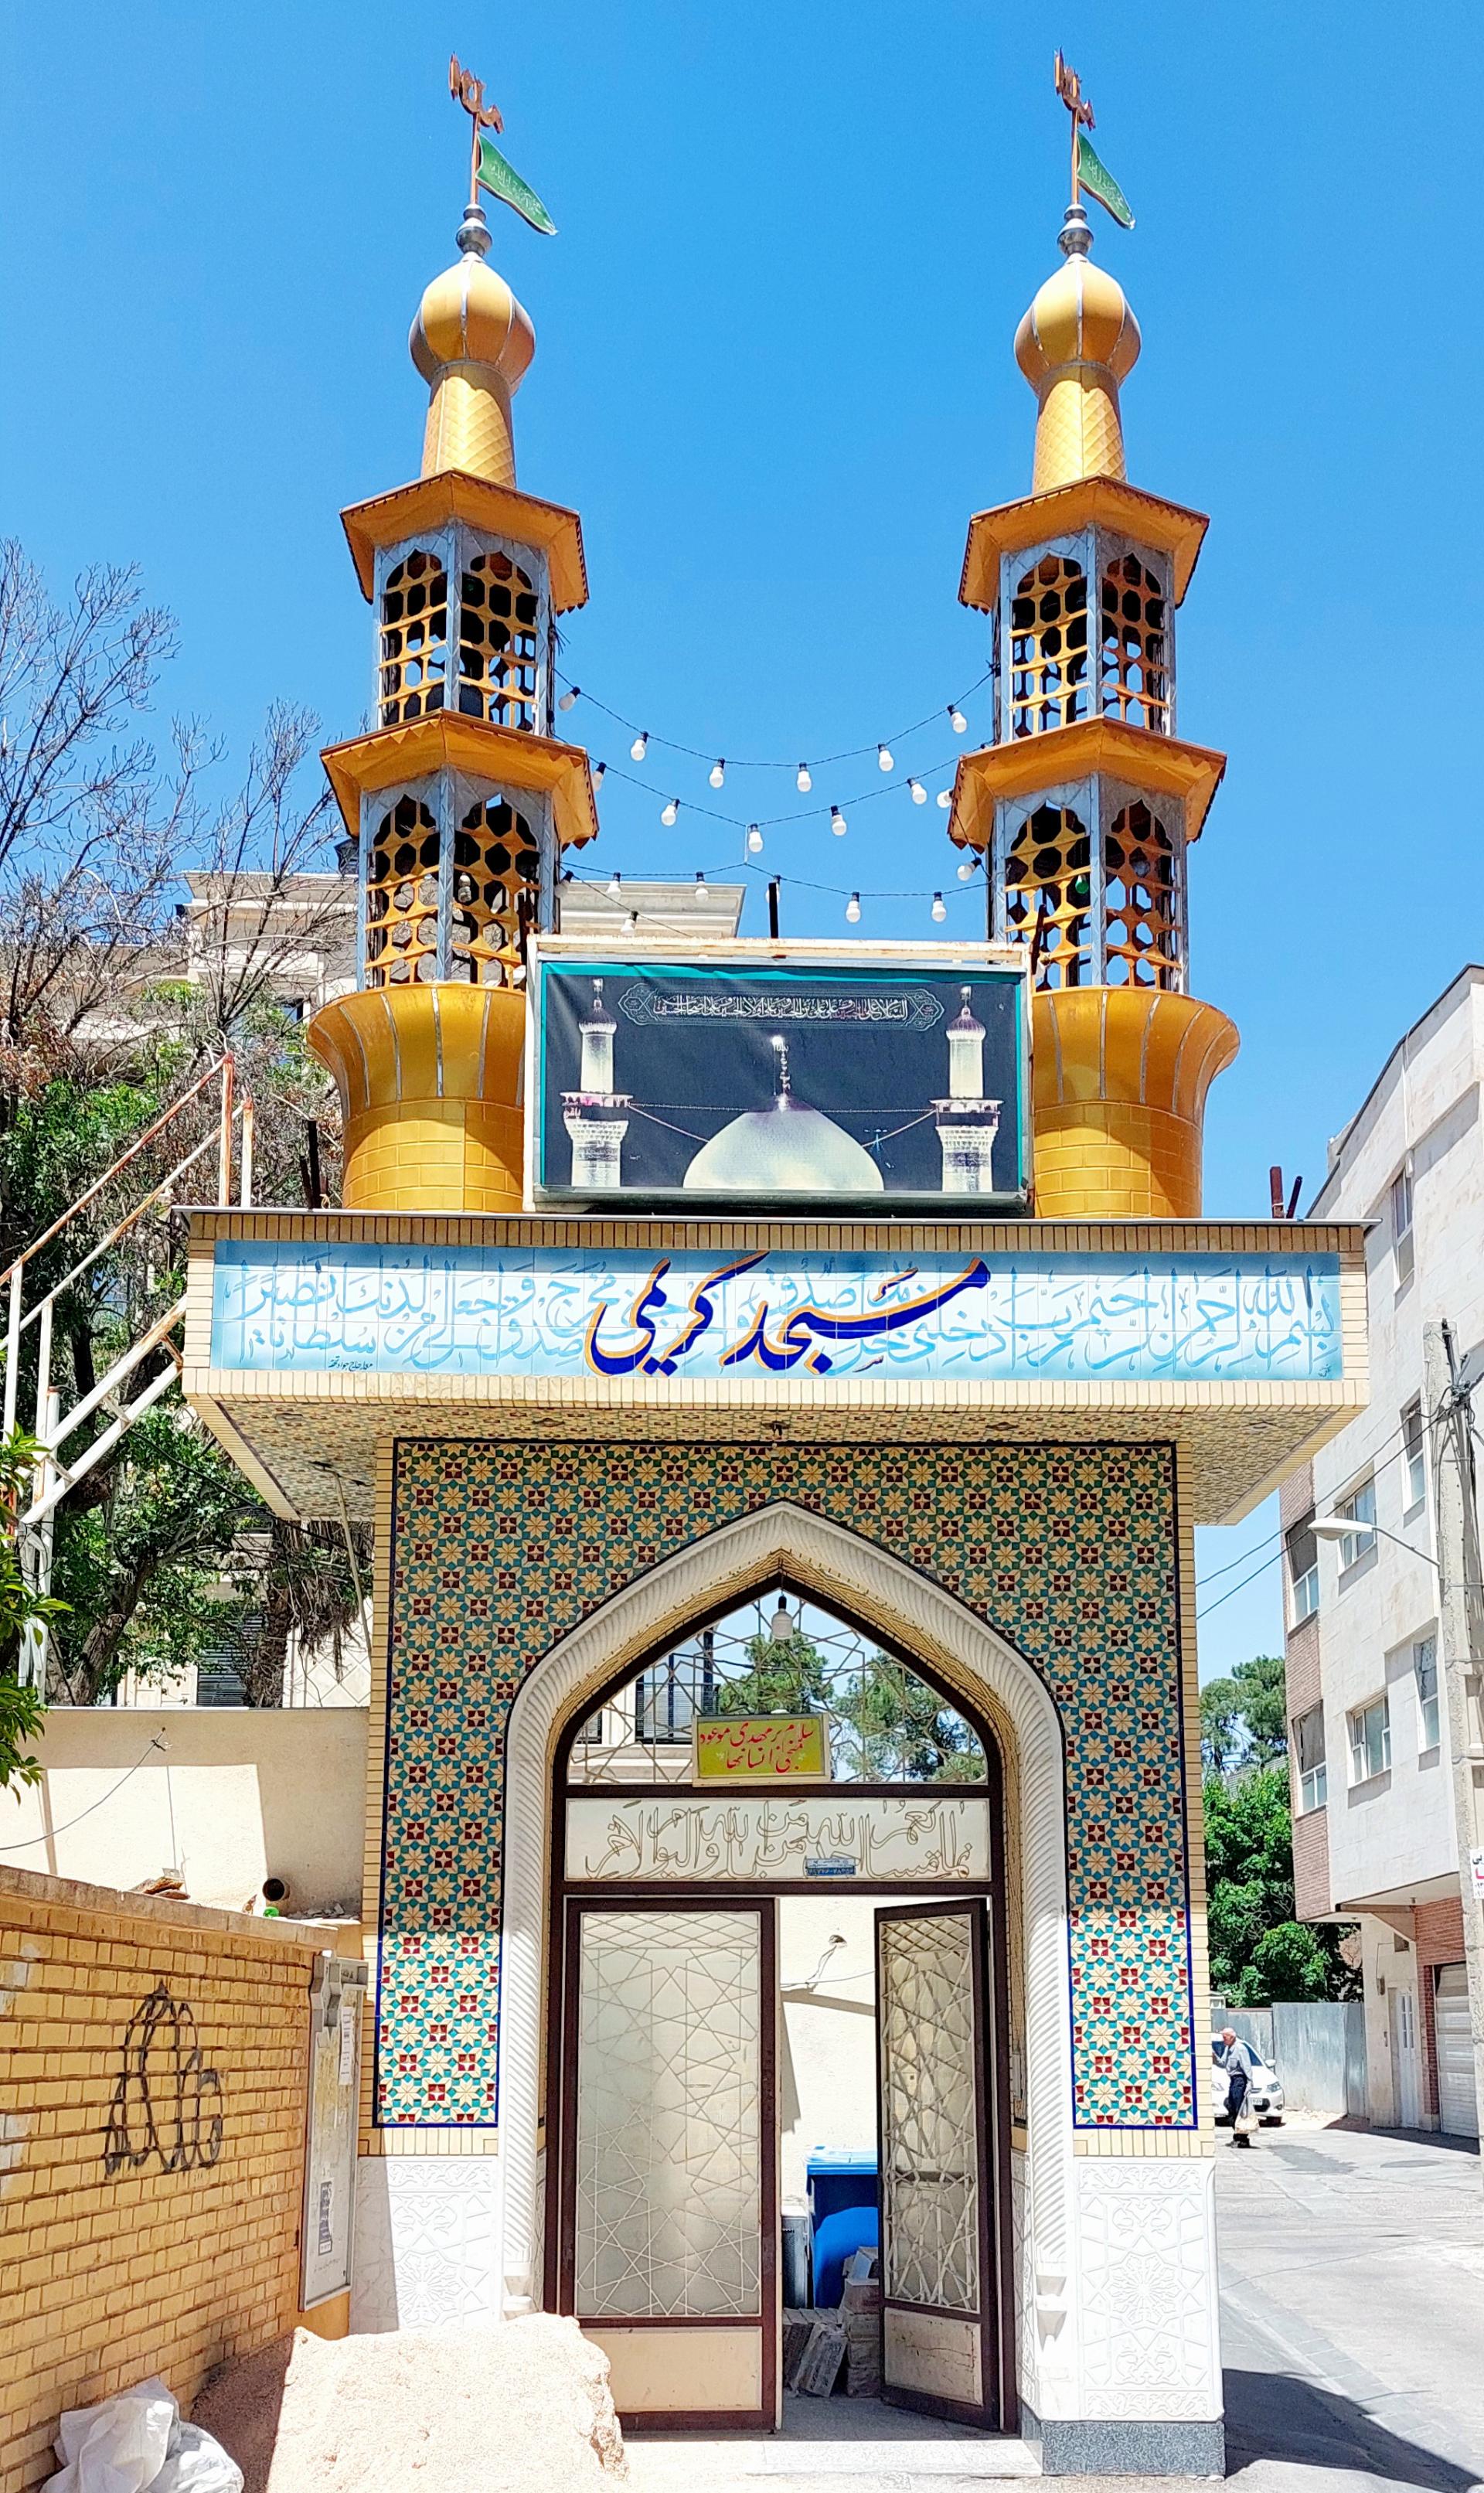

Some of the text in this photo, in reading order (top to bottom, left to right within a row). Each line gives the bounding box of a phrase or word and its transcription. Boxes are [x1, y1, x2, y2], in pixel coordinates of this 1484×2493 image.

[584, 1249, 992, 1378] مسجد کریمی
[699, 1727, 730, 1745] موعود
[730, 1722, 773, 1747] مهدی
